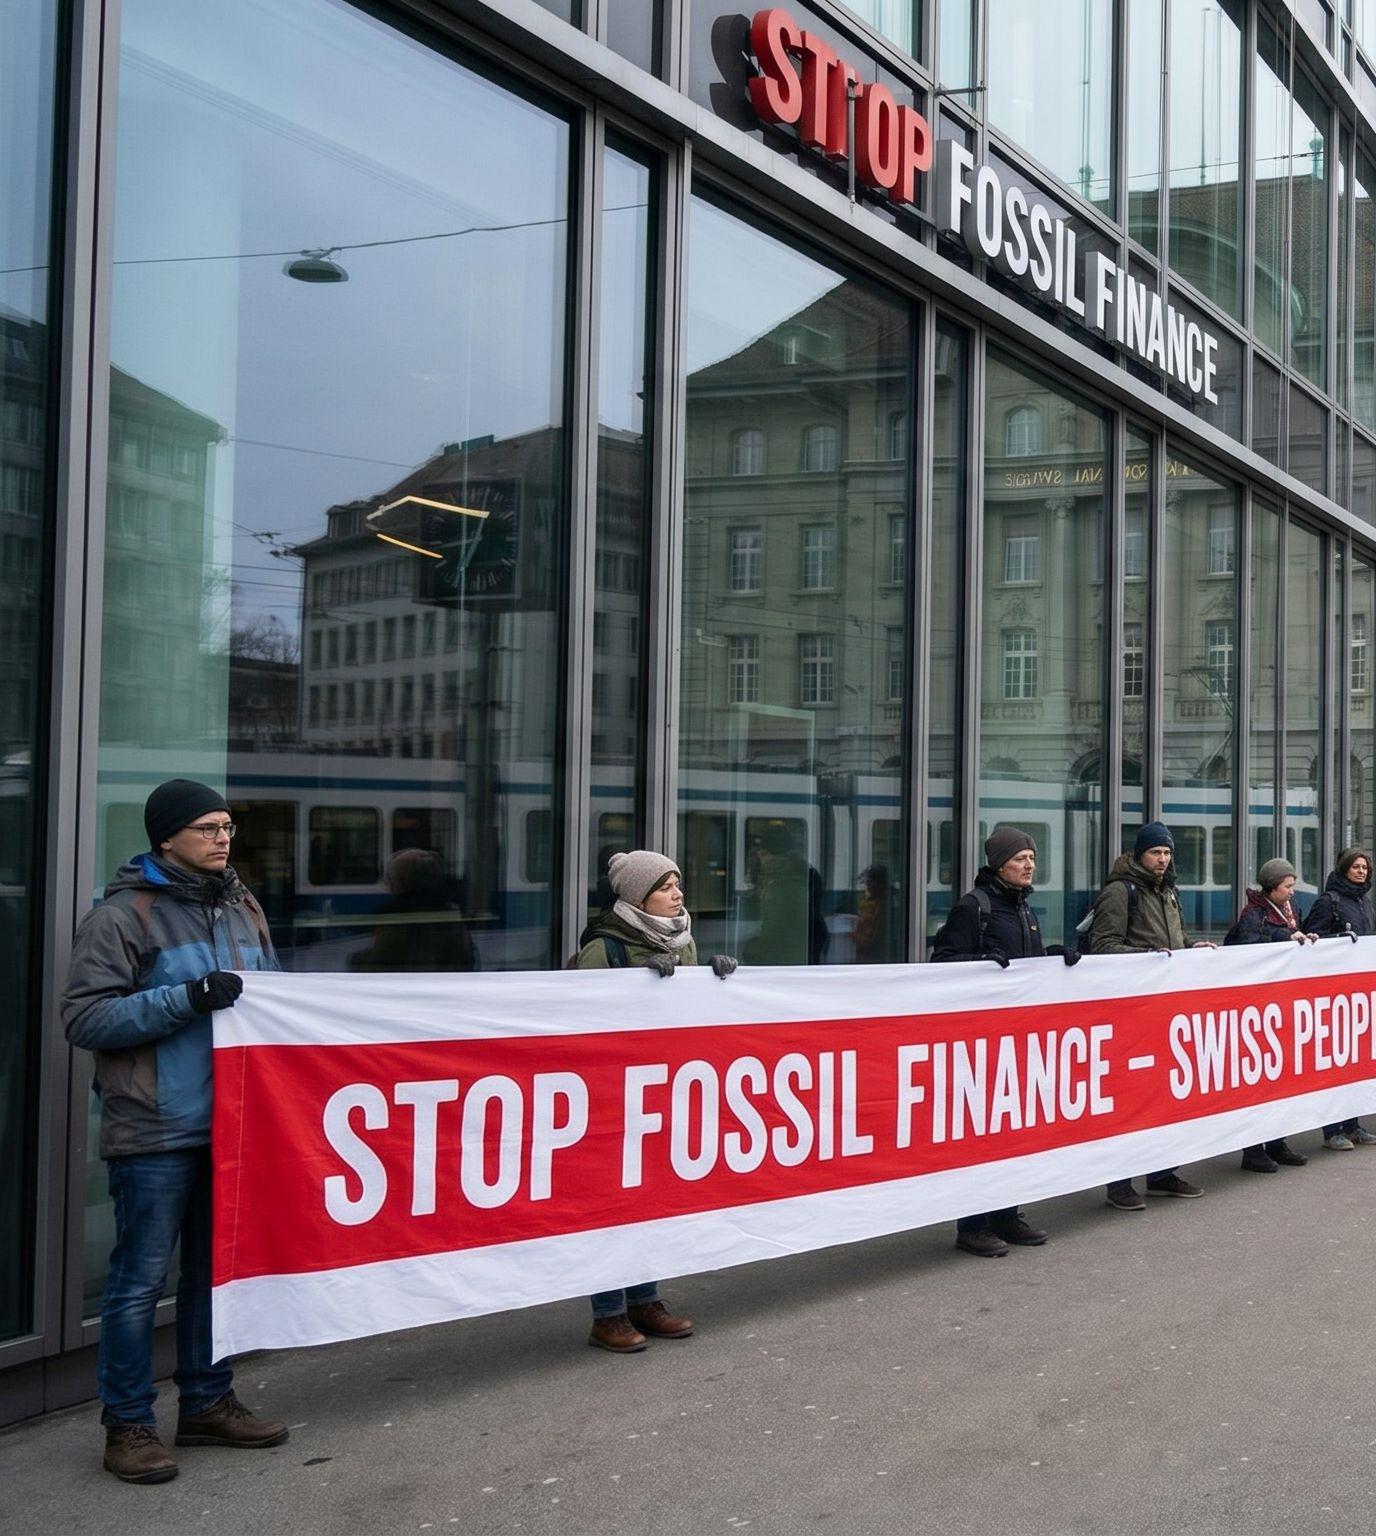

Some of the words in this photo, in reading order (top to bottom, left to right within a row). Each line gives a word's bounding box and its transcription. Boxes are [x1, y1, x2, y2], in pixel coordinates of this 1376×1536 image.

[950, 139, 1086, 318] FOSSIL
[1096, 251, 1218, 406] FINANCE
[322, 1071, 589, 1226] STOP
[621, 1050, 874, 1189] FOSSIL
[896, 1024, 1114, 1149] FINANCE
[1168, 1003, 1284, 1100] SWISS
